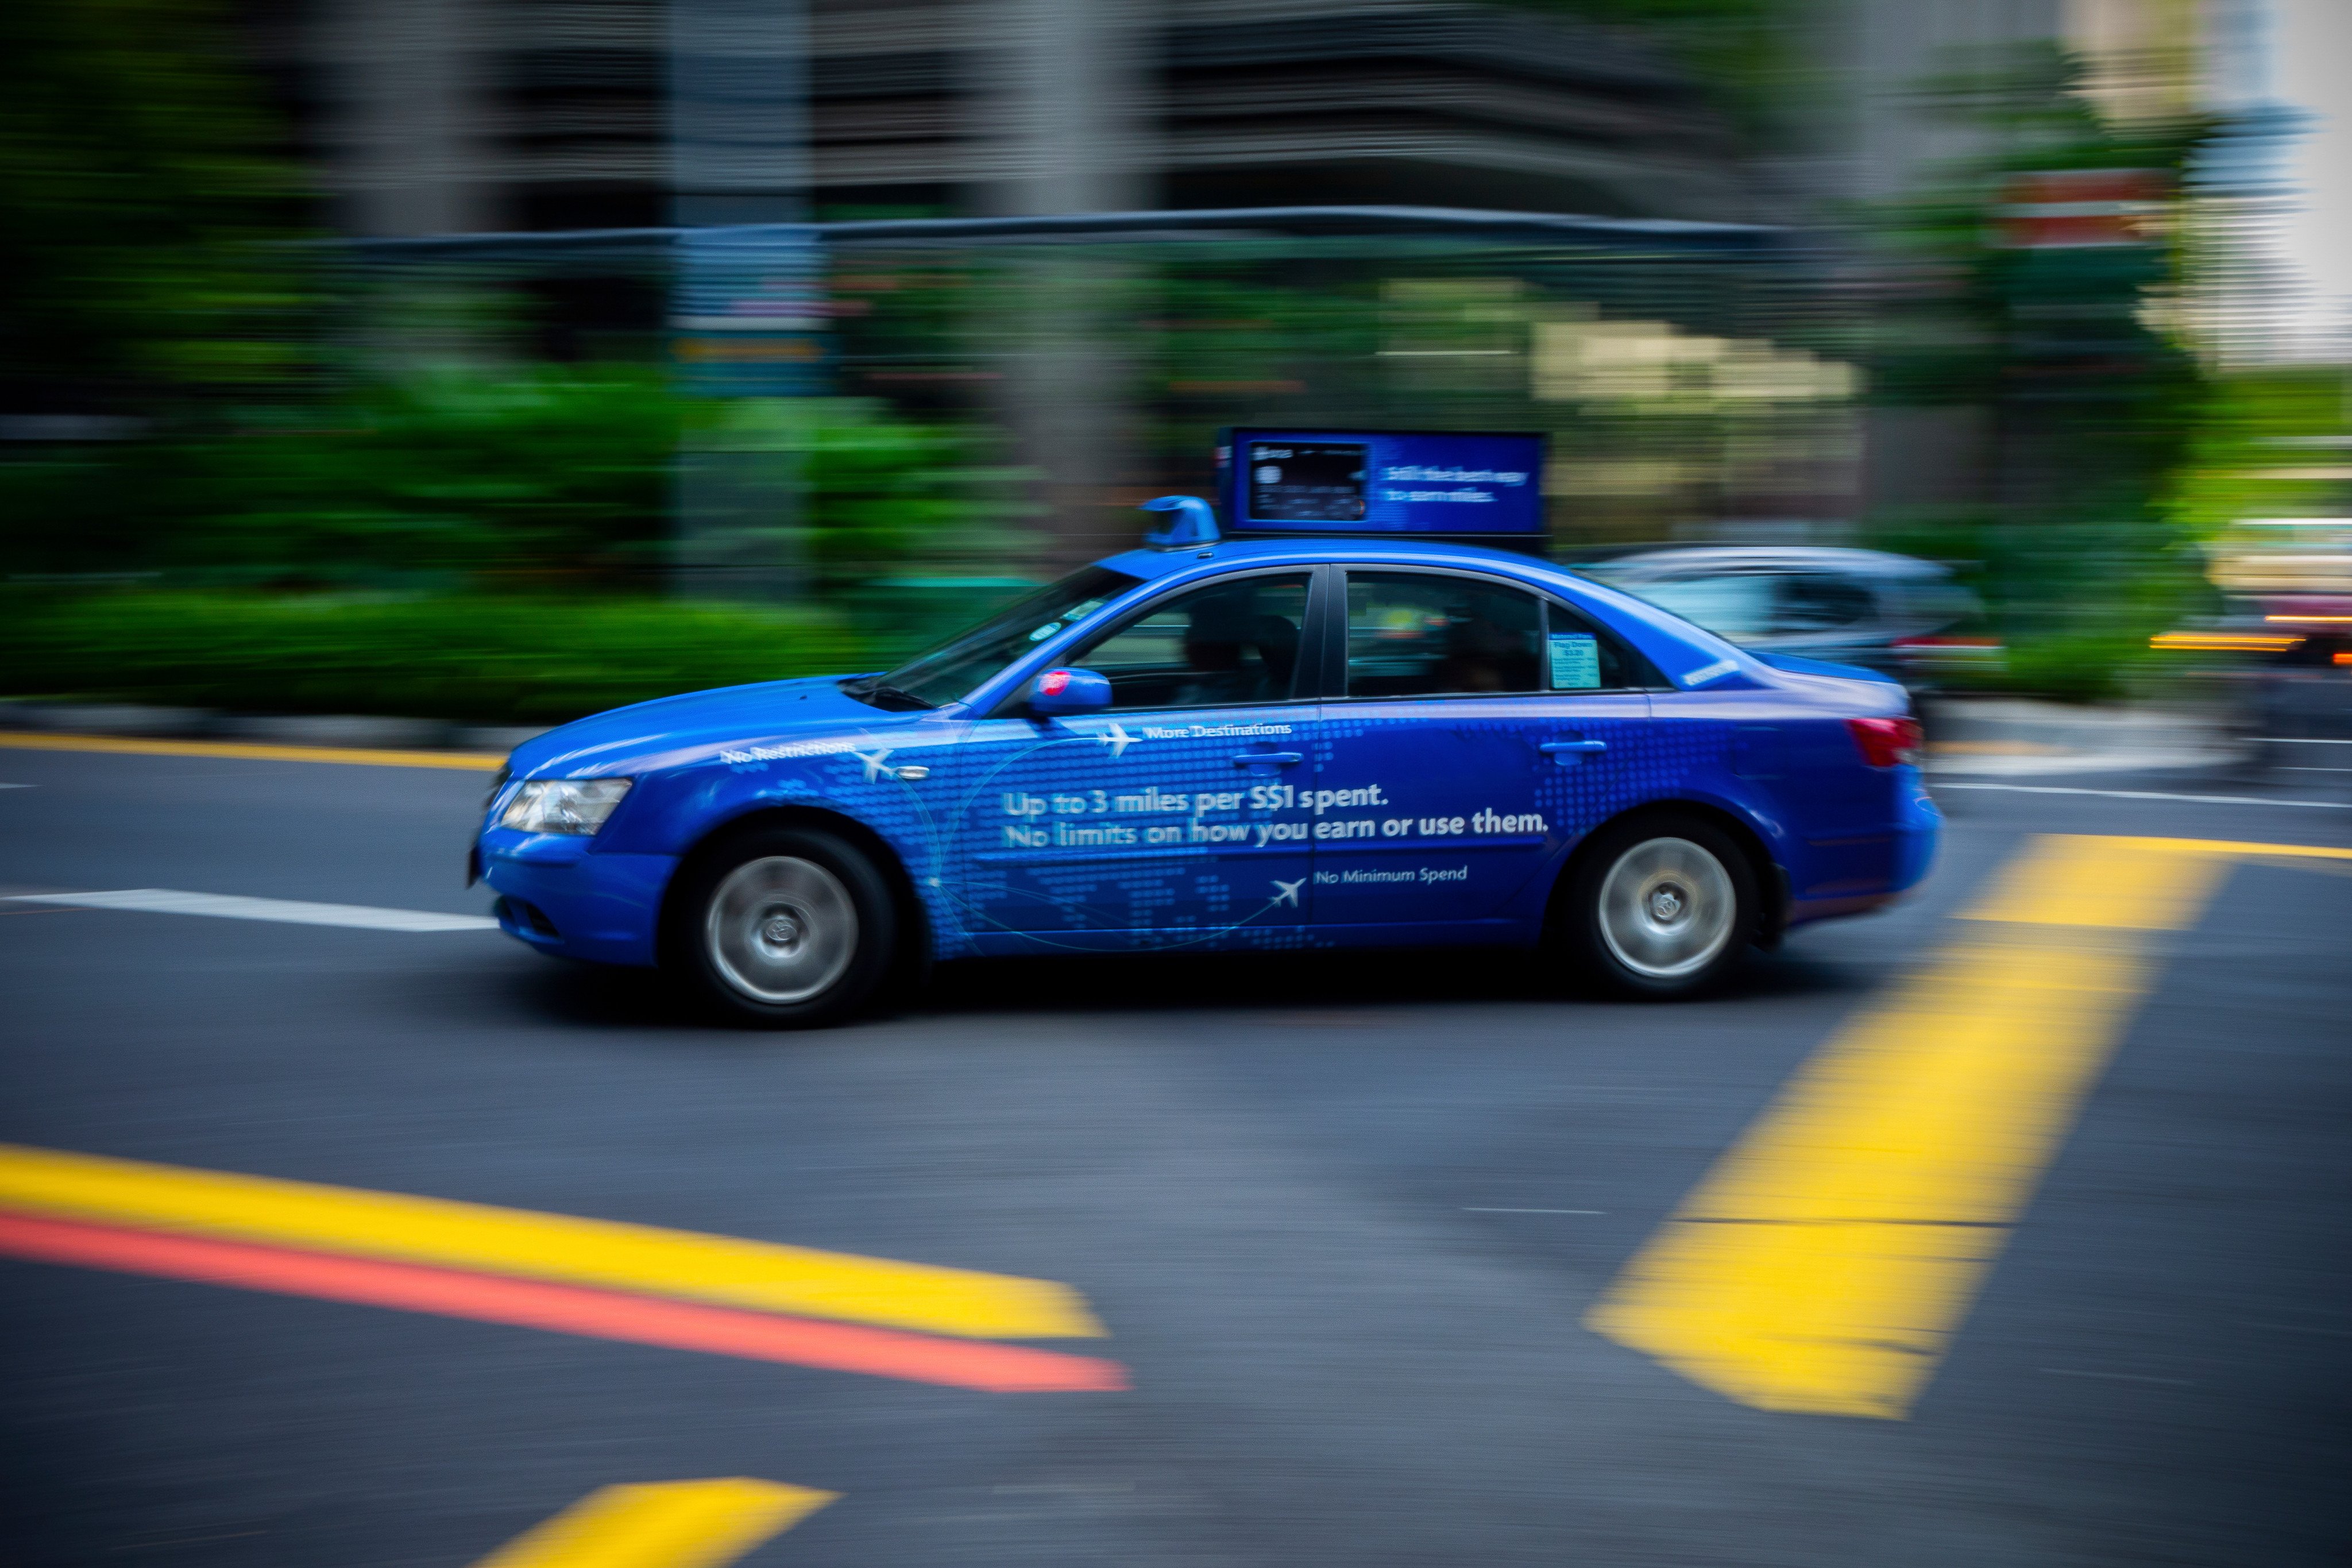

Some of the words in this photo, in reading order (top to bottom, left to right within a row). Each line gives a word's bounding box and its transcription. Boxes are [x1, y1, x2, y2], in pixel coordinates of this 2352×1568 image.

[1143, 725, 1189, 739] More
[1191, 721, 1293, 737] Destinations
[719, 749, 752, 764] No
[750, 741, 856, 760] Restrictions
[1002, 791, 1047, 822] Up
[1052, 793, 1087, 814] to
[1090, 790, 1109, 814] 3
[1115, 786, 1189, 813] miles
[1195, 791, 1246, 818] per
[1250, 782, 1295, 811] S$1
[1297, 783, 1389, 816] spent.
[1002, 824, 1049, 848] No
[1051, 821, 1138, 847] limits
[1148, 825, 1183, 844] on
[1187, 817, 1250, 844] how
[1254, 822, 1308, 848] you
[1311, 818, 1376, 839] earn
[1381, 818, 1413, 837] or
[1418, 816, 1465, 836] use
[1471, 807, 1549, 833] them.
[1313, 870, 1339, 885] No
[1340, 868, 1415, 884] Minimum
[1418, 864, 1468, 886] Spend
